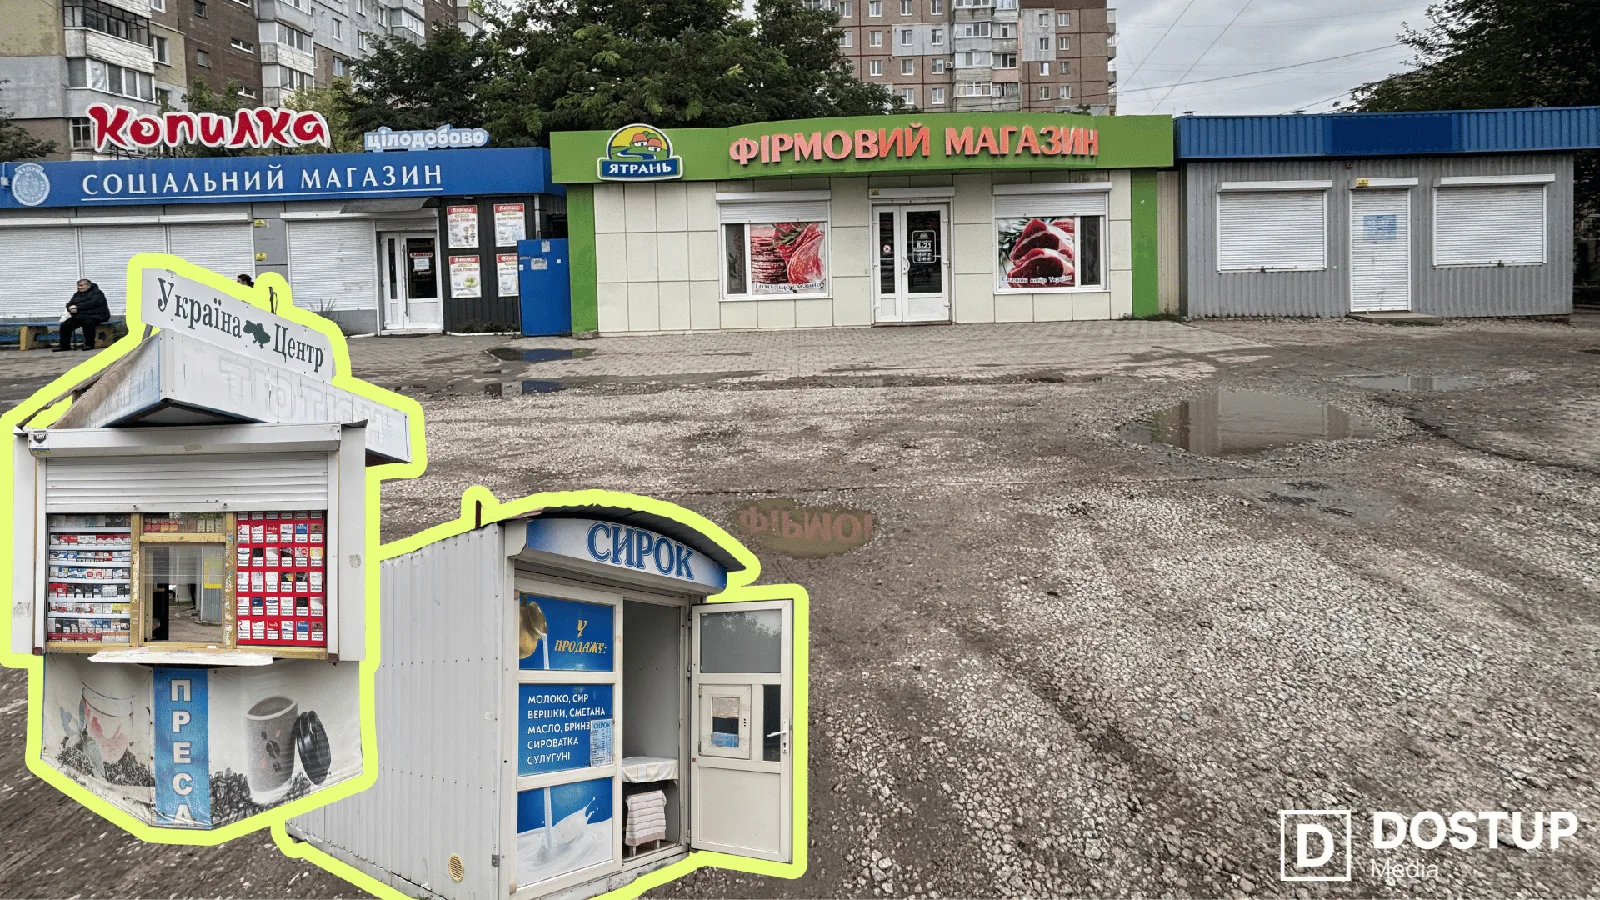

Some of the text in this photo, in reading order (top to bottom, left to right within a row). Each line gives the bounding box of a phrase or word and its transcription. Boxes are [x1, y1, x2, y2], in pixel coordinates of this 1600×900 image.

[88, 103, 330, 151] Копилка
[366, 128, 487, 150] цілодобово
[729, 123, 1100, 166] ФІРМОВИЙ МАГАЗИН
[608, 161, 673, 176] ЯТРАНЬ
[82, 164, 285, 197] СОЦІАЛЬНИЙ
[300, 163, 443, 190] МАГАЗИН
[157, 277, 325, 373] Україна Центр
[586, 522, 695, 580] СИРОК
[577, 619, 588, 638] У
[527, 693, 589, 704] МОЛОКО, СИР
[527, 706, 606, 719] ВЕРШКИ, СМЕТАНА
[527, 721, 590, 735] МАСЛО, БРИНЗ
[170, 677, 194, 824] ПРЕСА
[527, 736, 579, 750] СИРОВАТКА
[526, 752, 571, 765] СУЛУГУНІ
